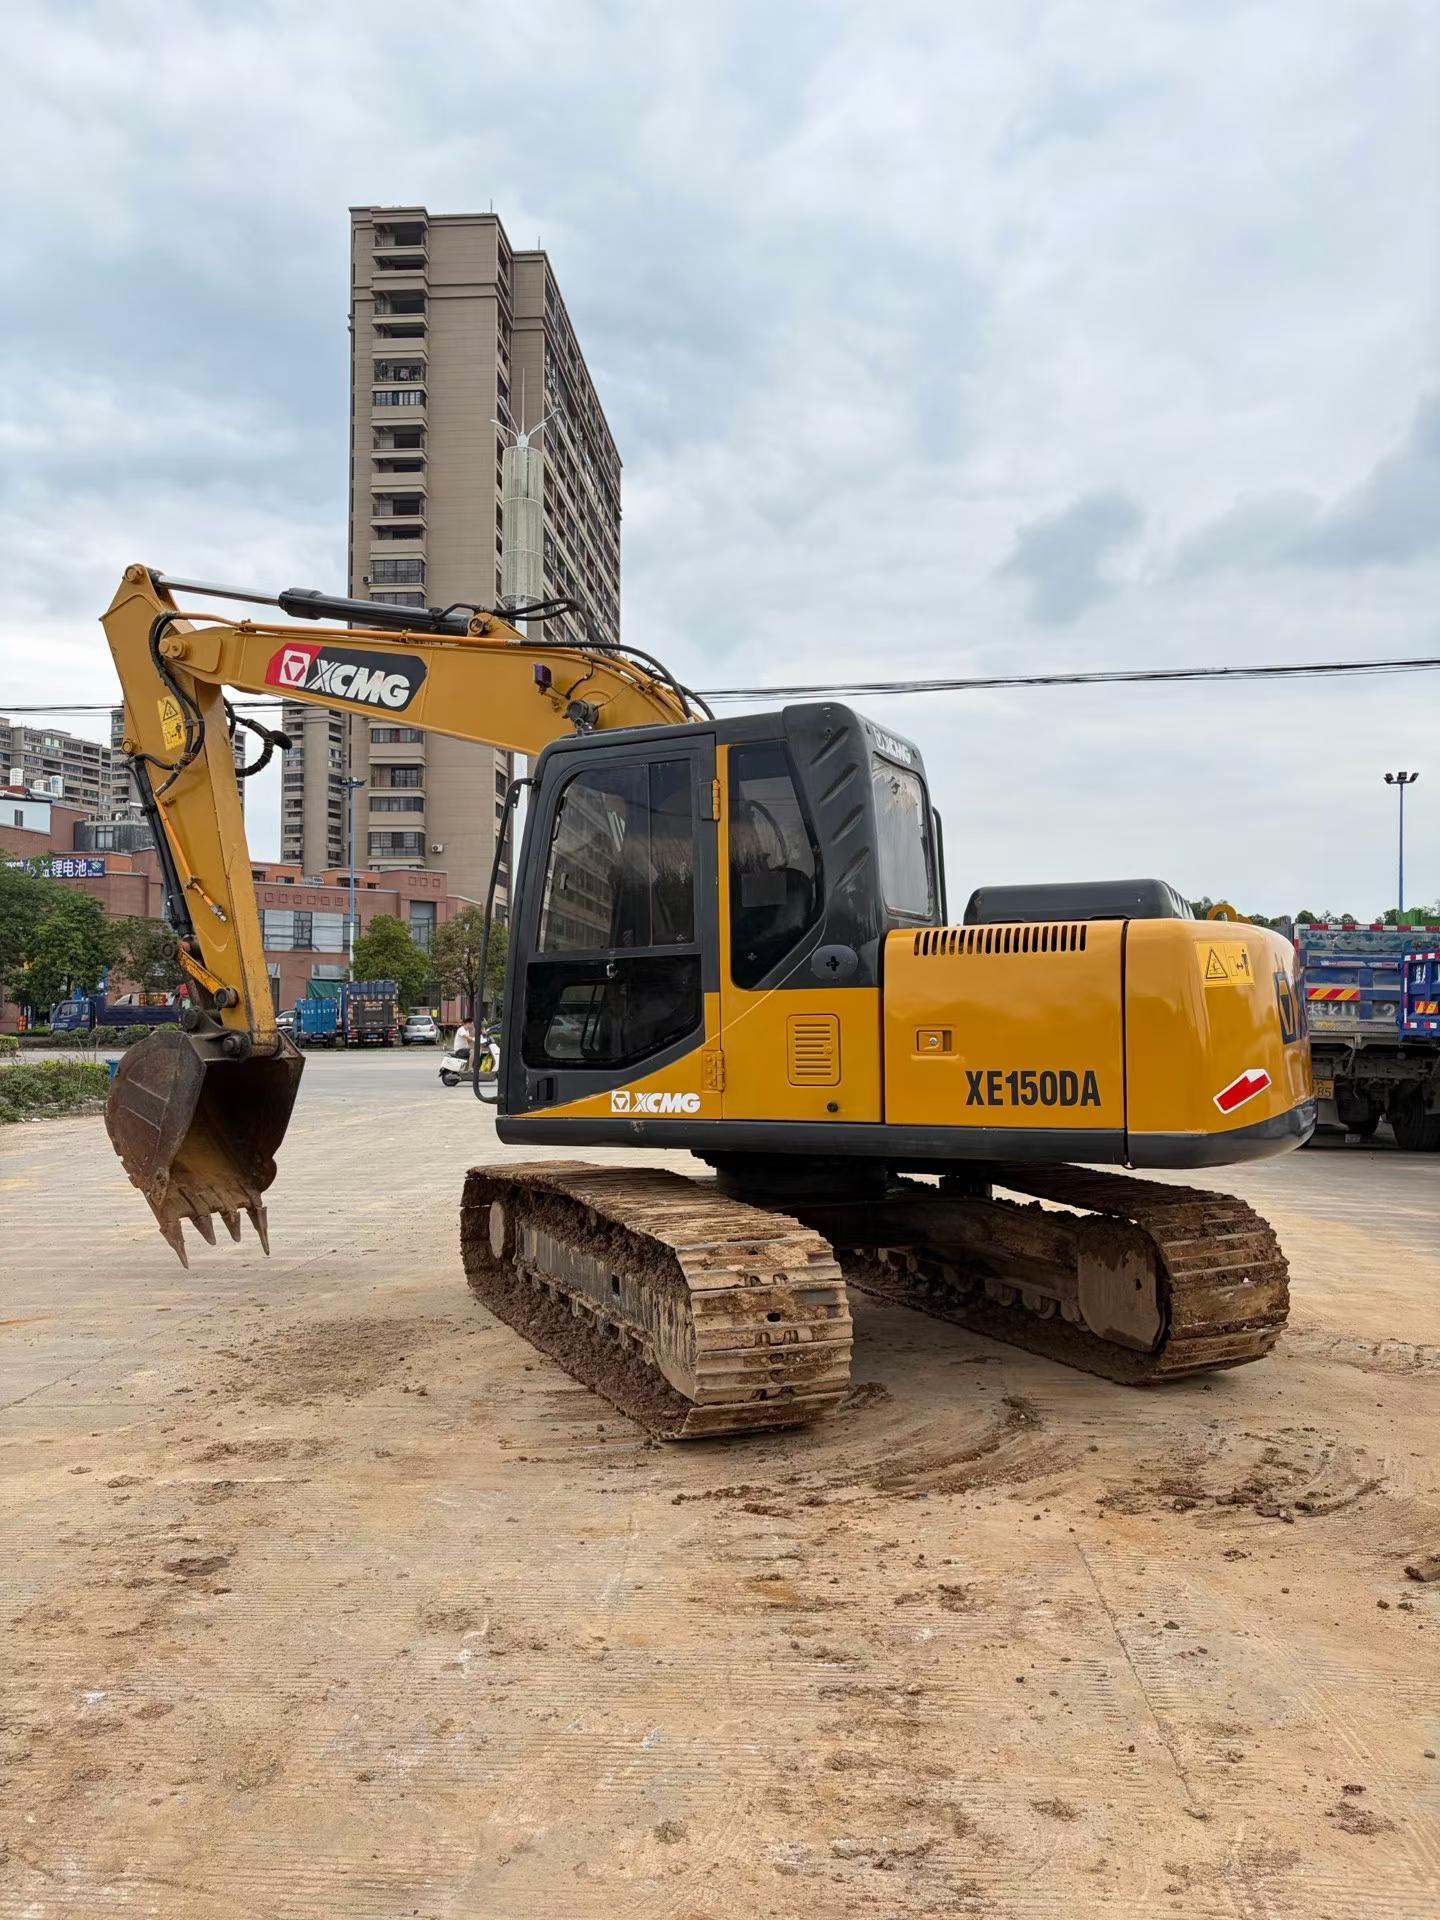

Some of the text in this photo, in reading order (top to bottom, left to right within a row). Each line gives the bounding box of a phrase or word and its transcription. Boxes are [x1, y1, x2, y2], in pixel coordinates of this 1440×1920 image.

[305, 658, 410, 708] XCMG
[882, 733, 912, 765] XCMG
[630, 1092, 701, 1113] XCMG
[965, 1070, 1102, 1107] XE150DA
